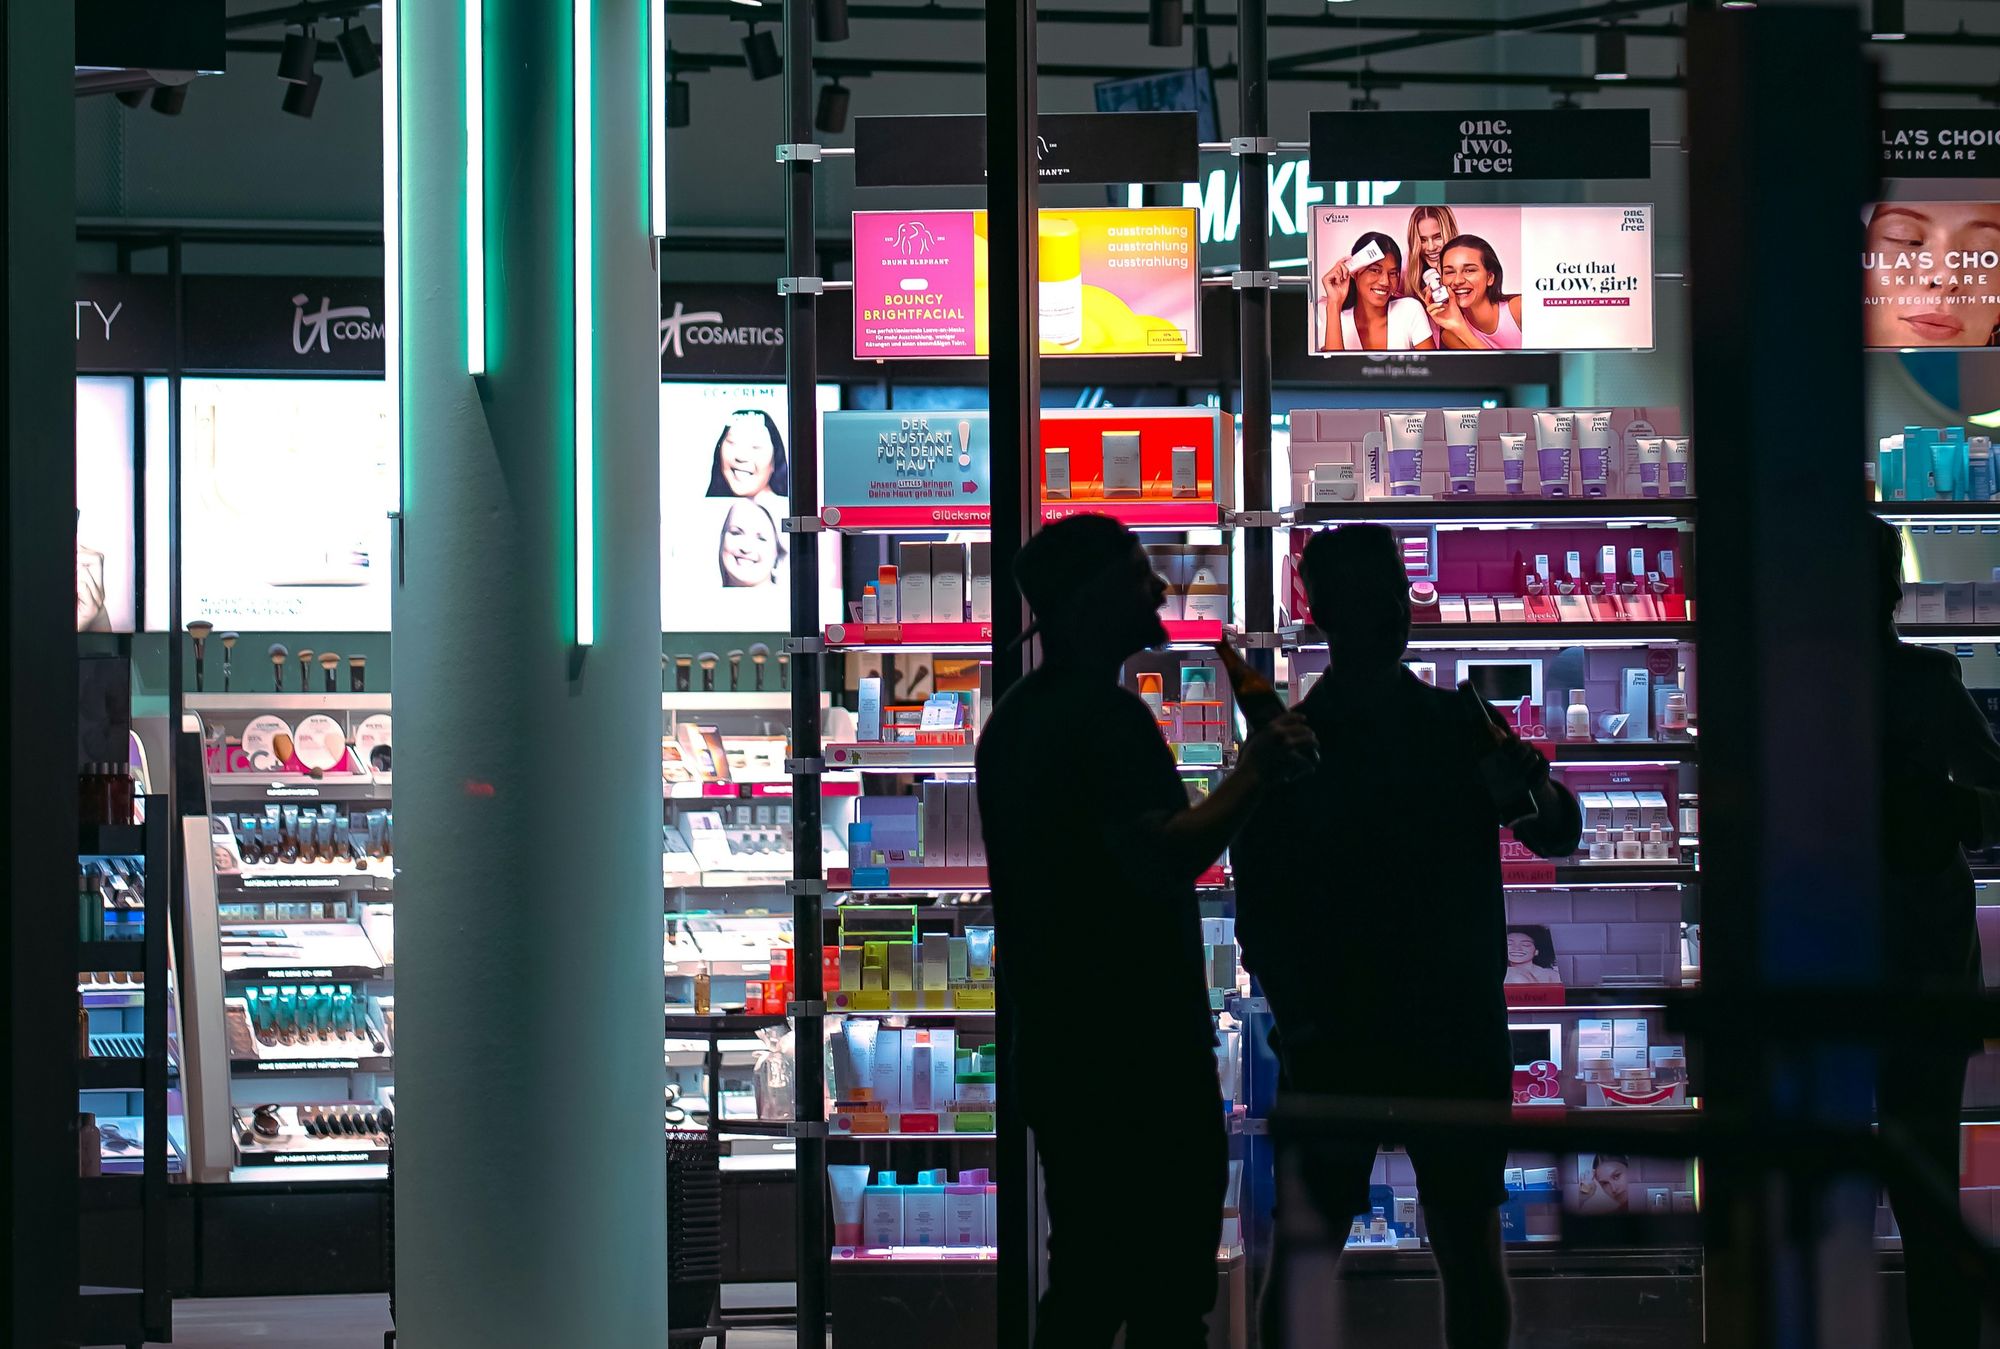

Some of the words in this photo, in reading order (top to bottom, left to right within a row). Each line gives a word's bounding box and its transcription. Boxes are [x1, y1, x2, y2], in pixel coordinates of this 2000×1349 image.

[1459, 119, 1512, 136] one.
[1460, 135, 1513, 155] two.
[1883, 150, 1977, 160] SKINCARE
[1453, 152, 1513, 174] free!
[1107, 225, 1189, 238] ausstrahlung
[1107, 240, 1189, 254] ausstrahlung
[881, 258, 908, 266] DRUNK
[1107, 255, 1189, 270] ausstrahlung
[1556, 261, 1582, 274] Get
[1585, 260, 1616, 274] that
[1535, 277, 1597, 292] GLOW,
[1599, 275, 1638, 294] girl!
[1880, 274, 1987, 286] SKINCARE
[884, 294, 944, 306] BOUNCY
[1897, 296, 1941, 305] BEGINS
[1945, 295, 1976, 305] WITH
[863, 308, 965, 321] BRIGHTFACIAL
[685, 325, 785, 346] COSMETICS
[901, 419, 929, 431] DER
[879, 432, 952, 445] NEUSTART
[877, 445, 905, 458] FÜR
[911, 445, 953, 458] DEINE
[896, 459, 936, 471] HAUT
[1045, 509, 1063, 520] die
[1511, 695, 1532, 728] 1
[1527, 1060, 1560, 1099] 3
